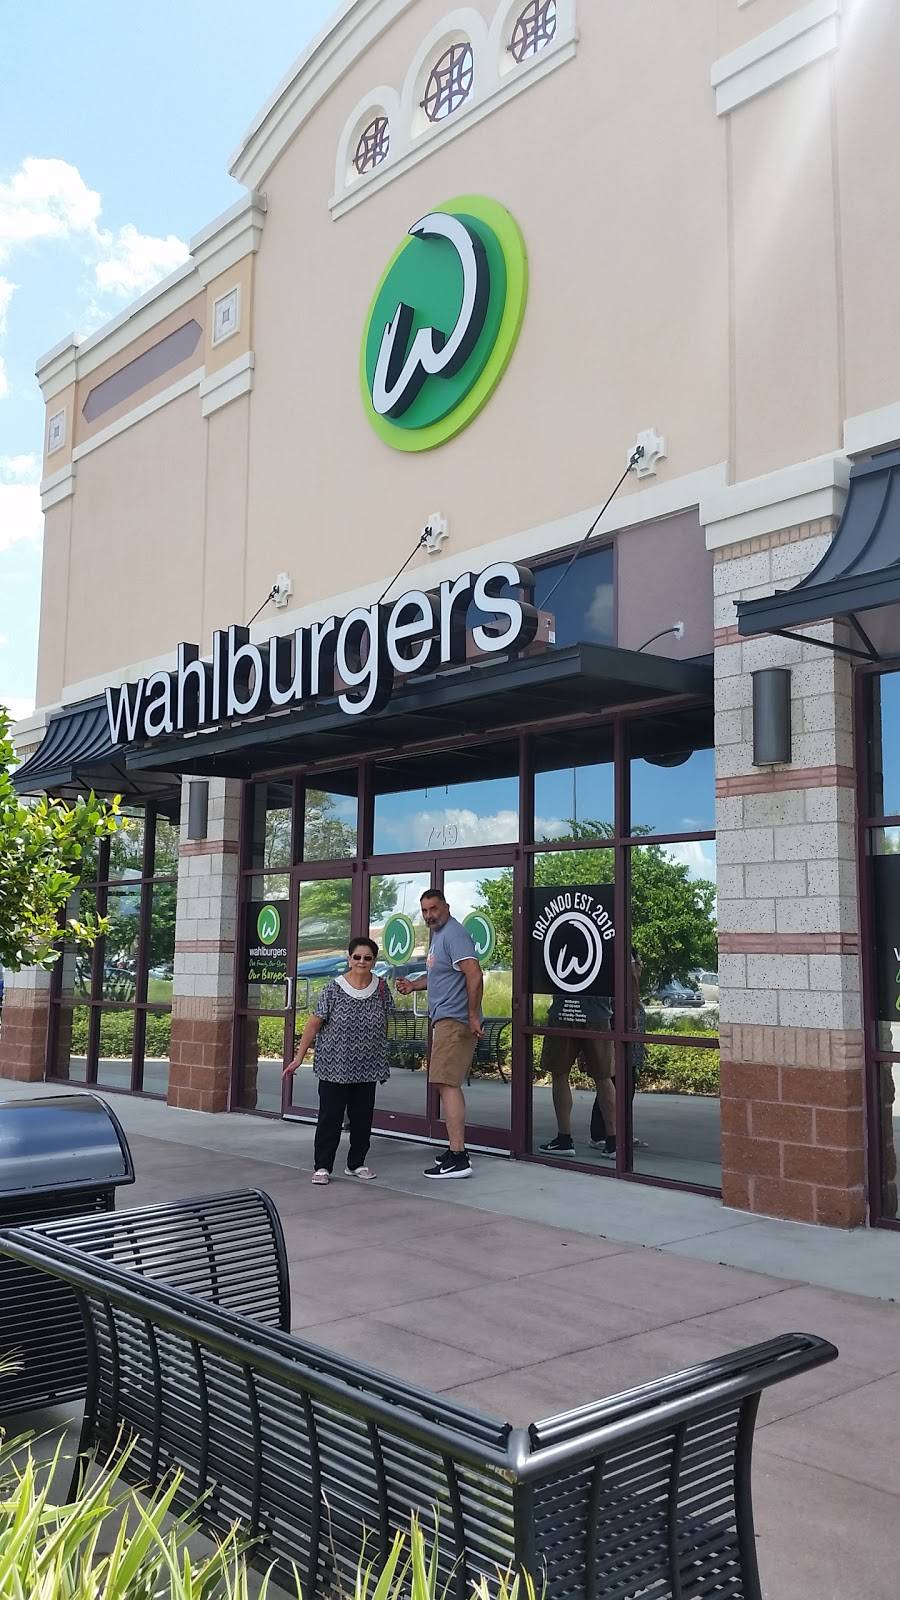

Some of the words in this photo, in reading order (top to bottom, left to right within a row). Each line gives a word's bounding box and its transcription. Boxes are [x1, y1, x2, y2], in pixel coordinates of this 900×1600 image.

[104, 561, 527, 745] wahlburgers
[532, 892, 572, 941] ORLANDO
[574, 892, 594, 915] EST.
[592, 904, 616, 940] 2016
[249, 946, 287, 959] wahlburgers
